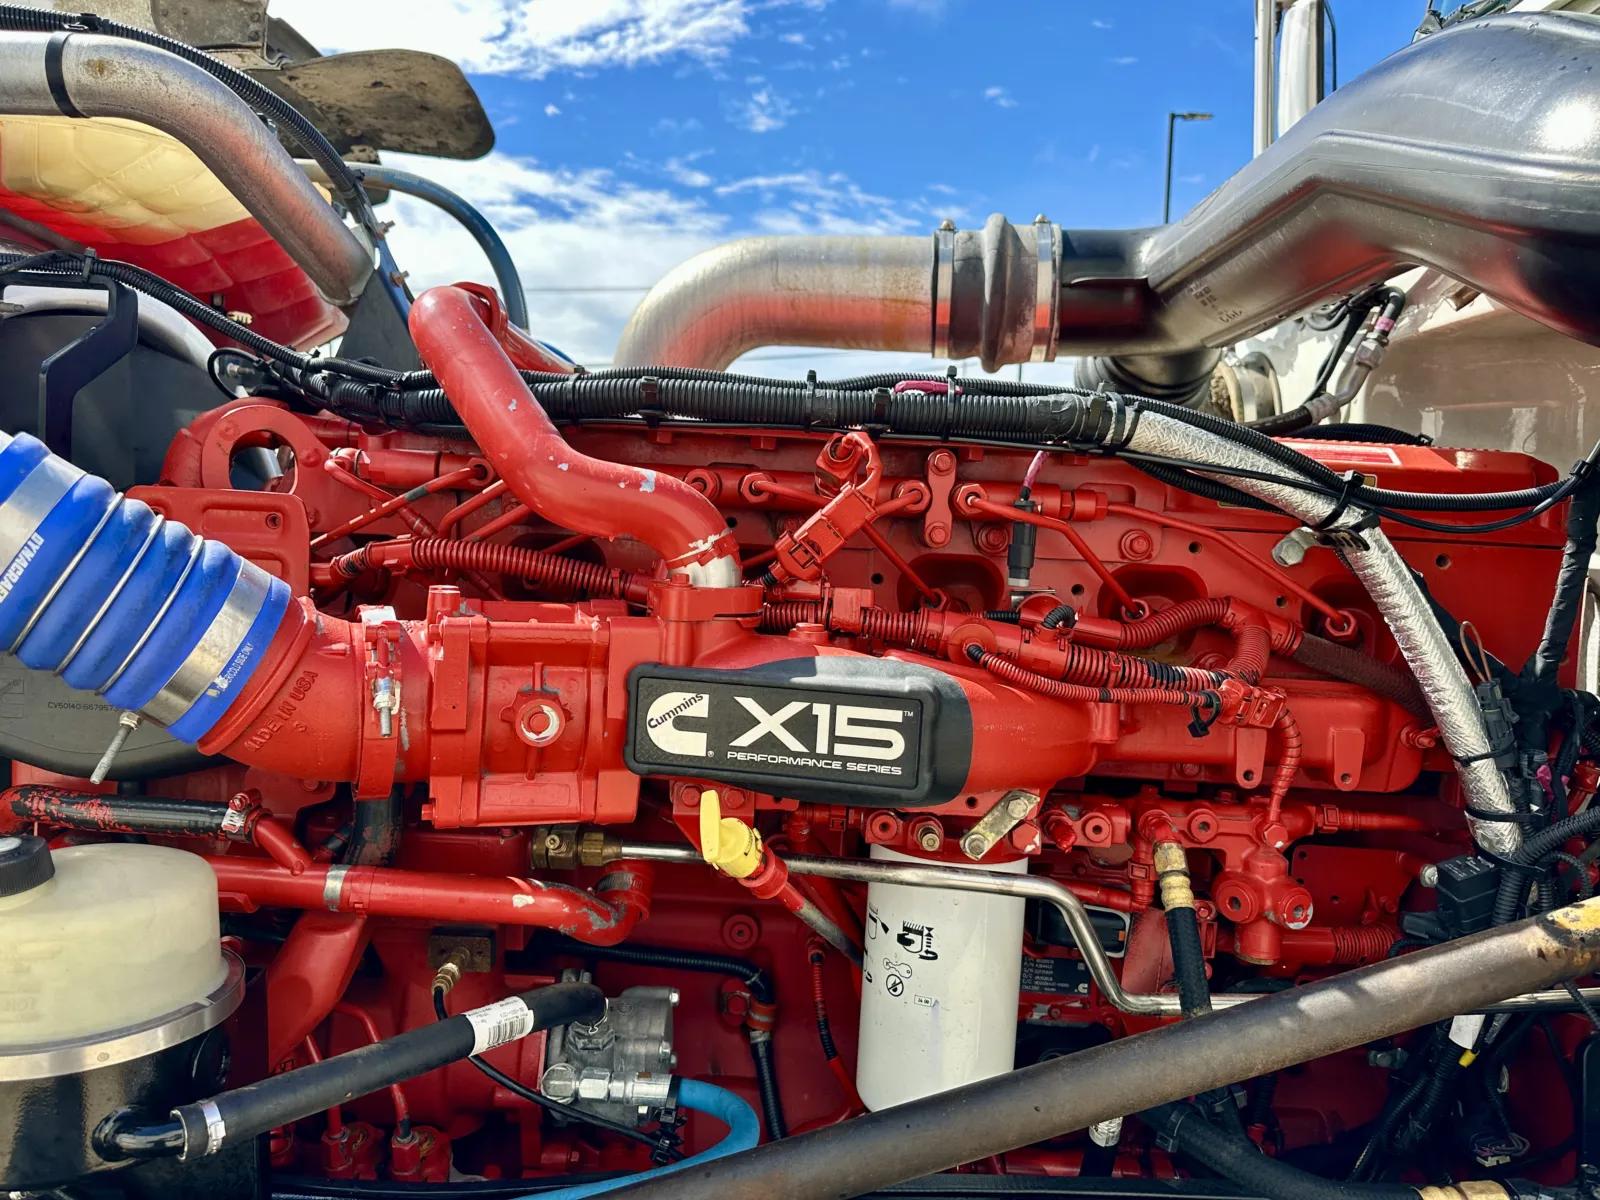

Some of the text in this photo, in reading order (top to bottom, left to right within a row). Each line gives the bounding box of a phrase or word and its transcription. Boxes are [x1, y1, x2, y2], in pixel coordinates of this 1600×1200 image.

[274, 700, 296, 720] IN
[289, 670, 318, 701] USA
[647, 693, 704, 729] Cummins
[728, 696, 905, 760] X15
[727, 751, 902, 775] PERFORMANCE SERIES
